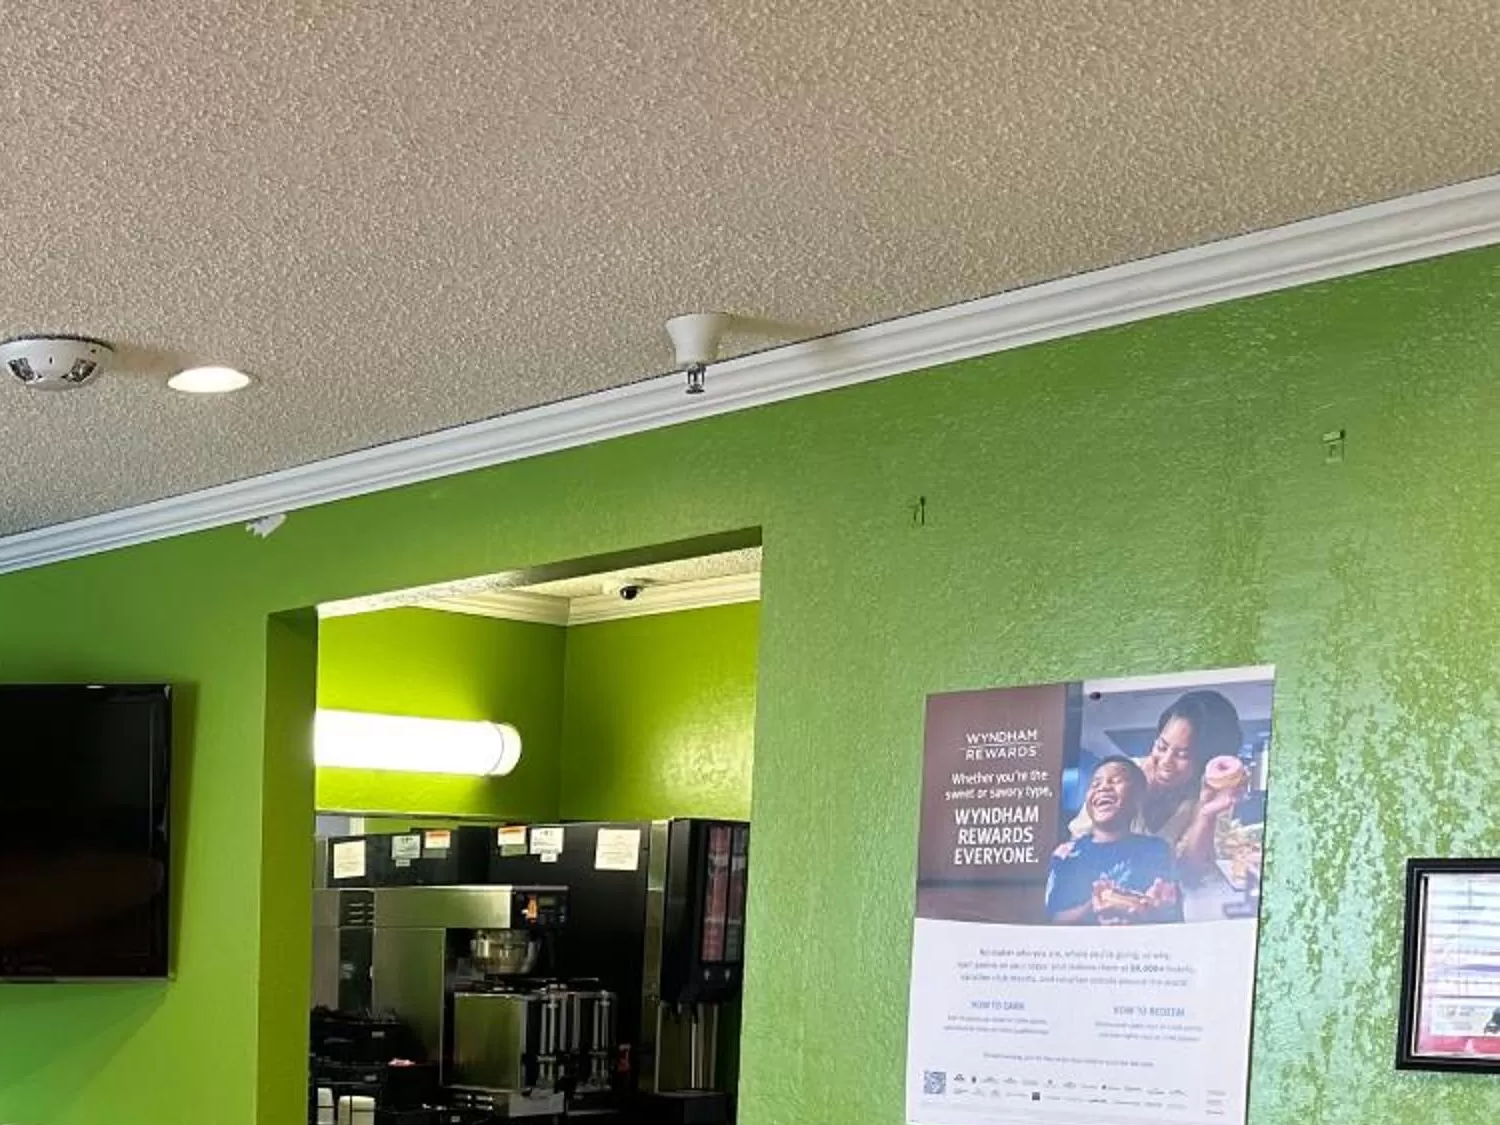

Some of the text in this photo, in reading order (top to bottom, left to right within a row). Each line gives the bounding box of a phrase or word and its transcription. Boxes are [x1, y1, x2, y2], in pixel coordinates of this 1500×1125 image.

[965, 729, 1038, 744] WYNDHAM
[965, 745, 1038, 760] REWARDS
[951, 768, 1049, 784] Whether you're the
[978, 788, 988, 799] or
[990, 787, 1023, 800] savory
[955, 805, 1039, 824] WYNDHAM
[958, 826, 1034, 845] REWARDS
[954, 846, 1039, 865] EVERYONE.
